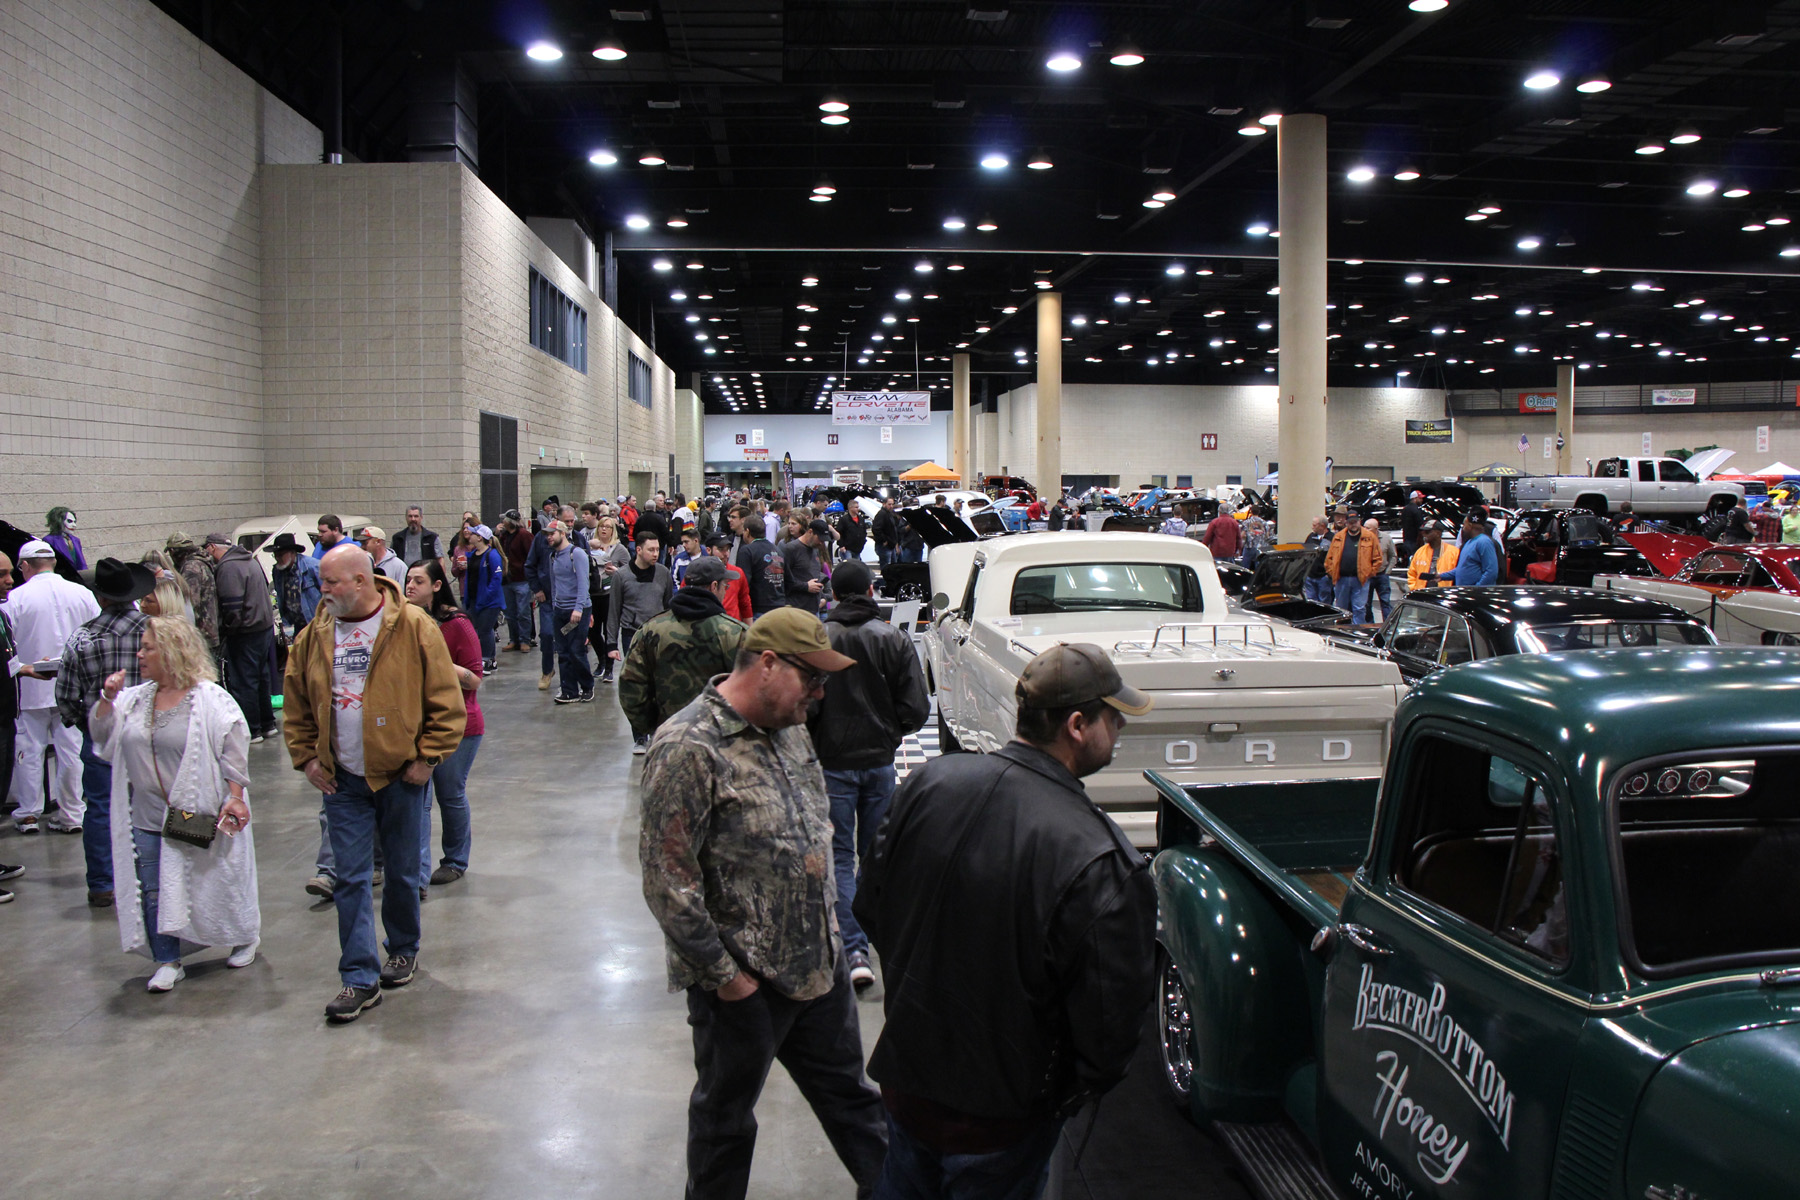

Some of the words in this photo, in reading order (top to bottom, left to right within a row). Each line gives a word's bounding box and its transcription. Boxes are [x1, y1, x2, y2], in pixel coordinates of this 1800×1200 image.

[335, 640, 363, 648] merican
[333, 655, 371, 664] HEVRO
[1112, 738, 1352, 765] ORD
[1373, 1050, 1469, 1185] Honey
[1355, 1141, 1414, 1200] AMORY
[1350, 1172, 1373, 1198] JEFF
